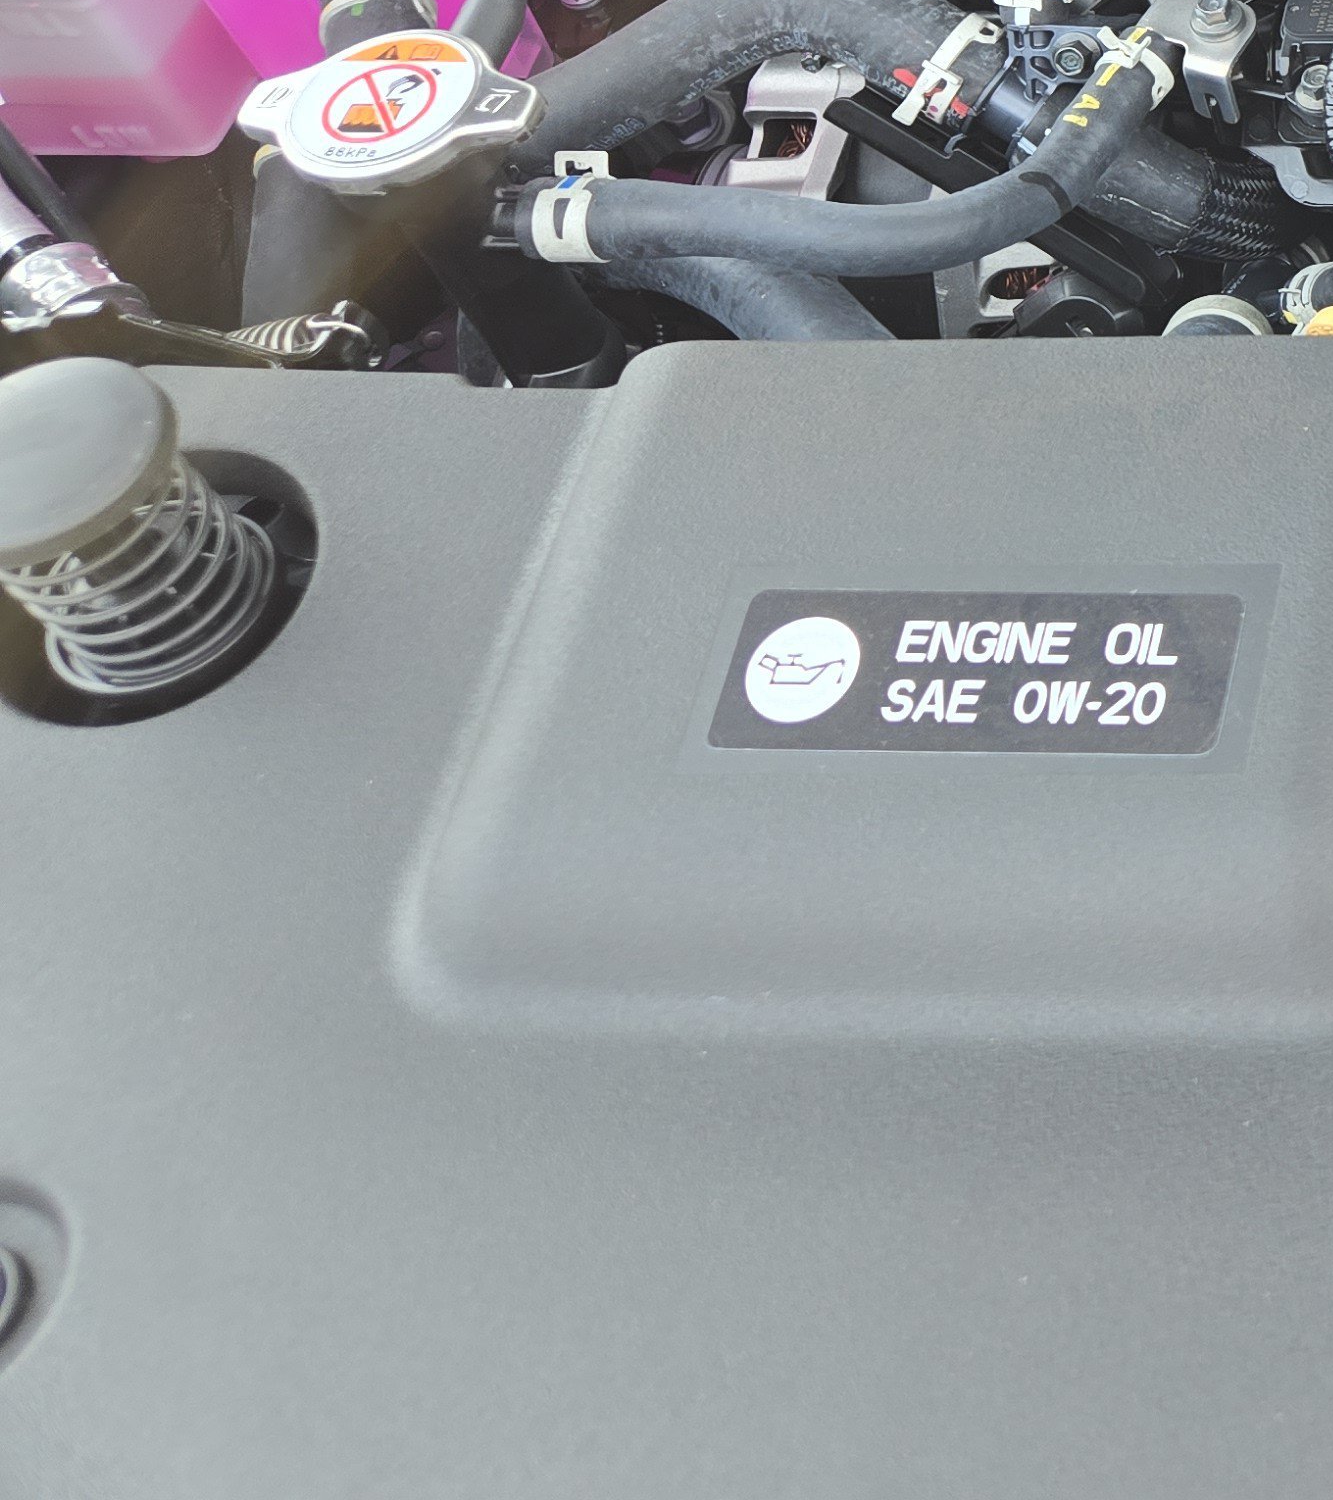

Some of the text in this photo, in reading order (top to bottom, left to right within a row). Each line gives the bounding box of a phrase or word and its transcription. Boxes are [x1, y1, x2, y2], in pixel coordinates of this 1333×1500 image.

[323, 145, 377, 159] 88kPa
[895, 620, 1178, 666] ENGINE OIL
[880, 679, 1167, 725] SAE 0W-20
